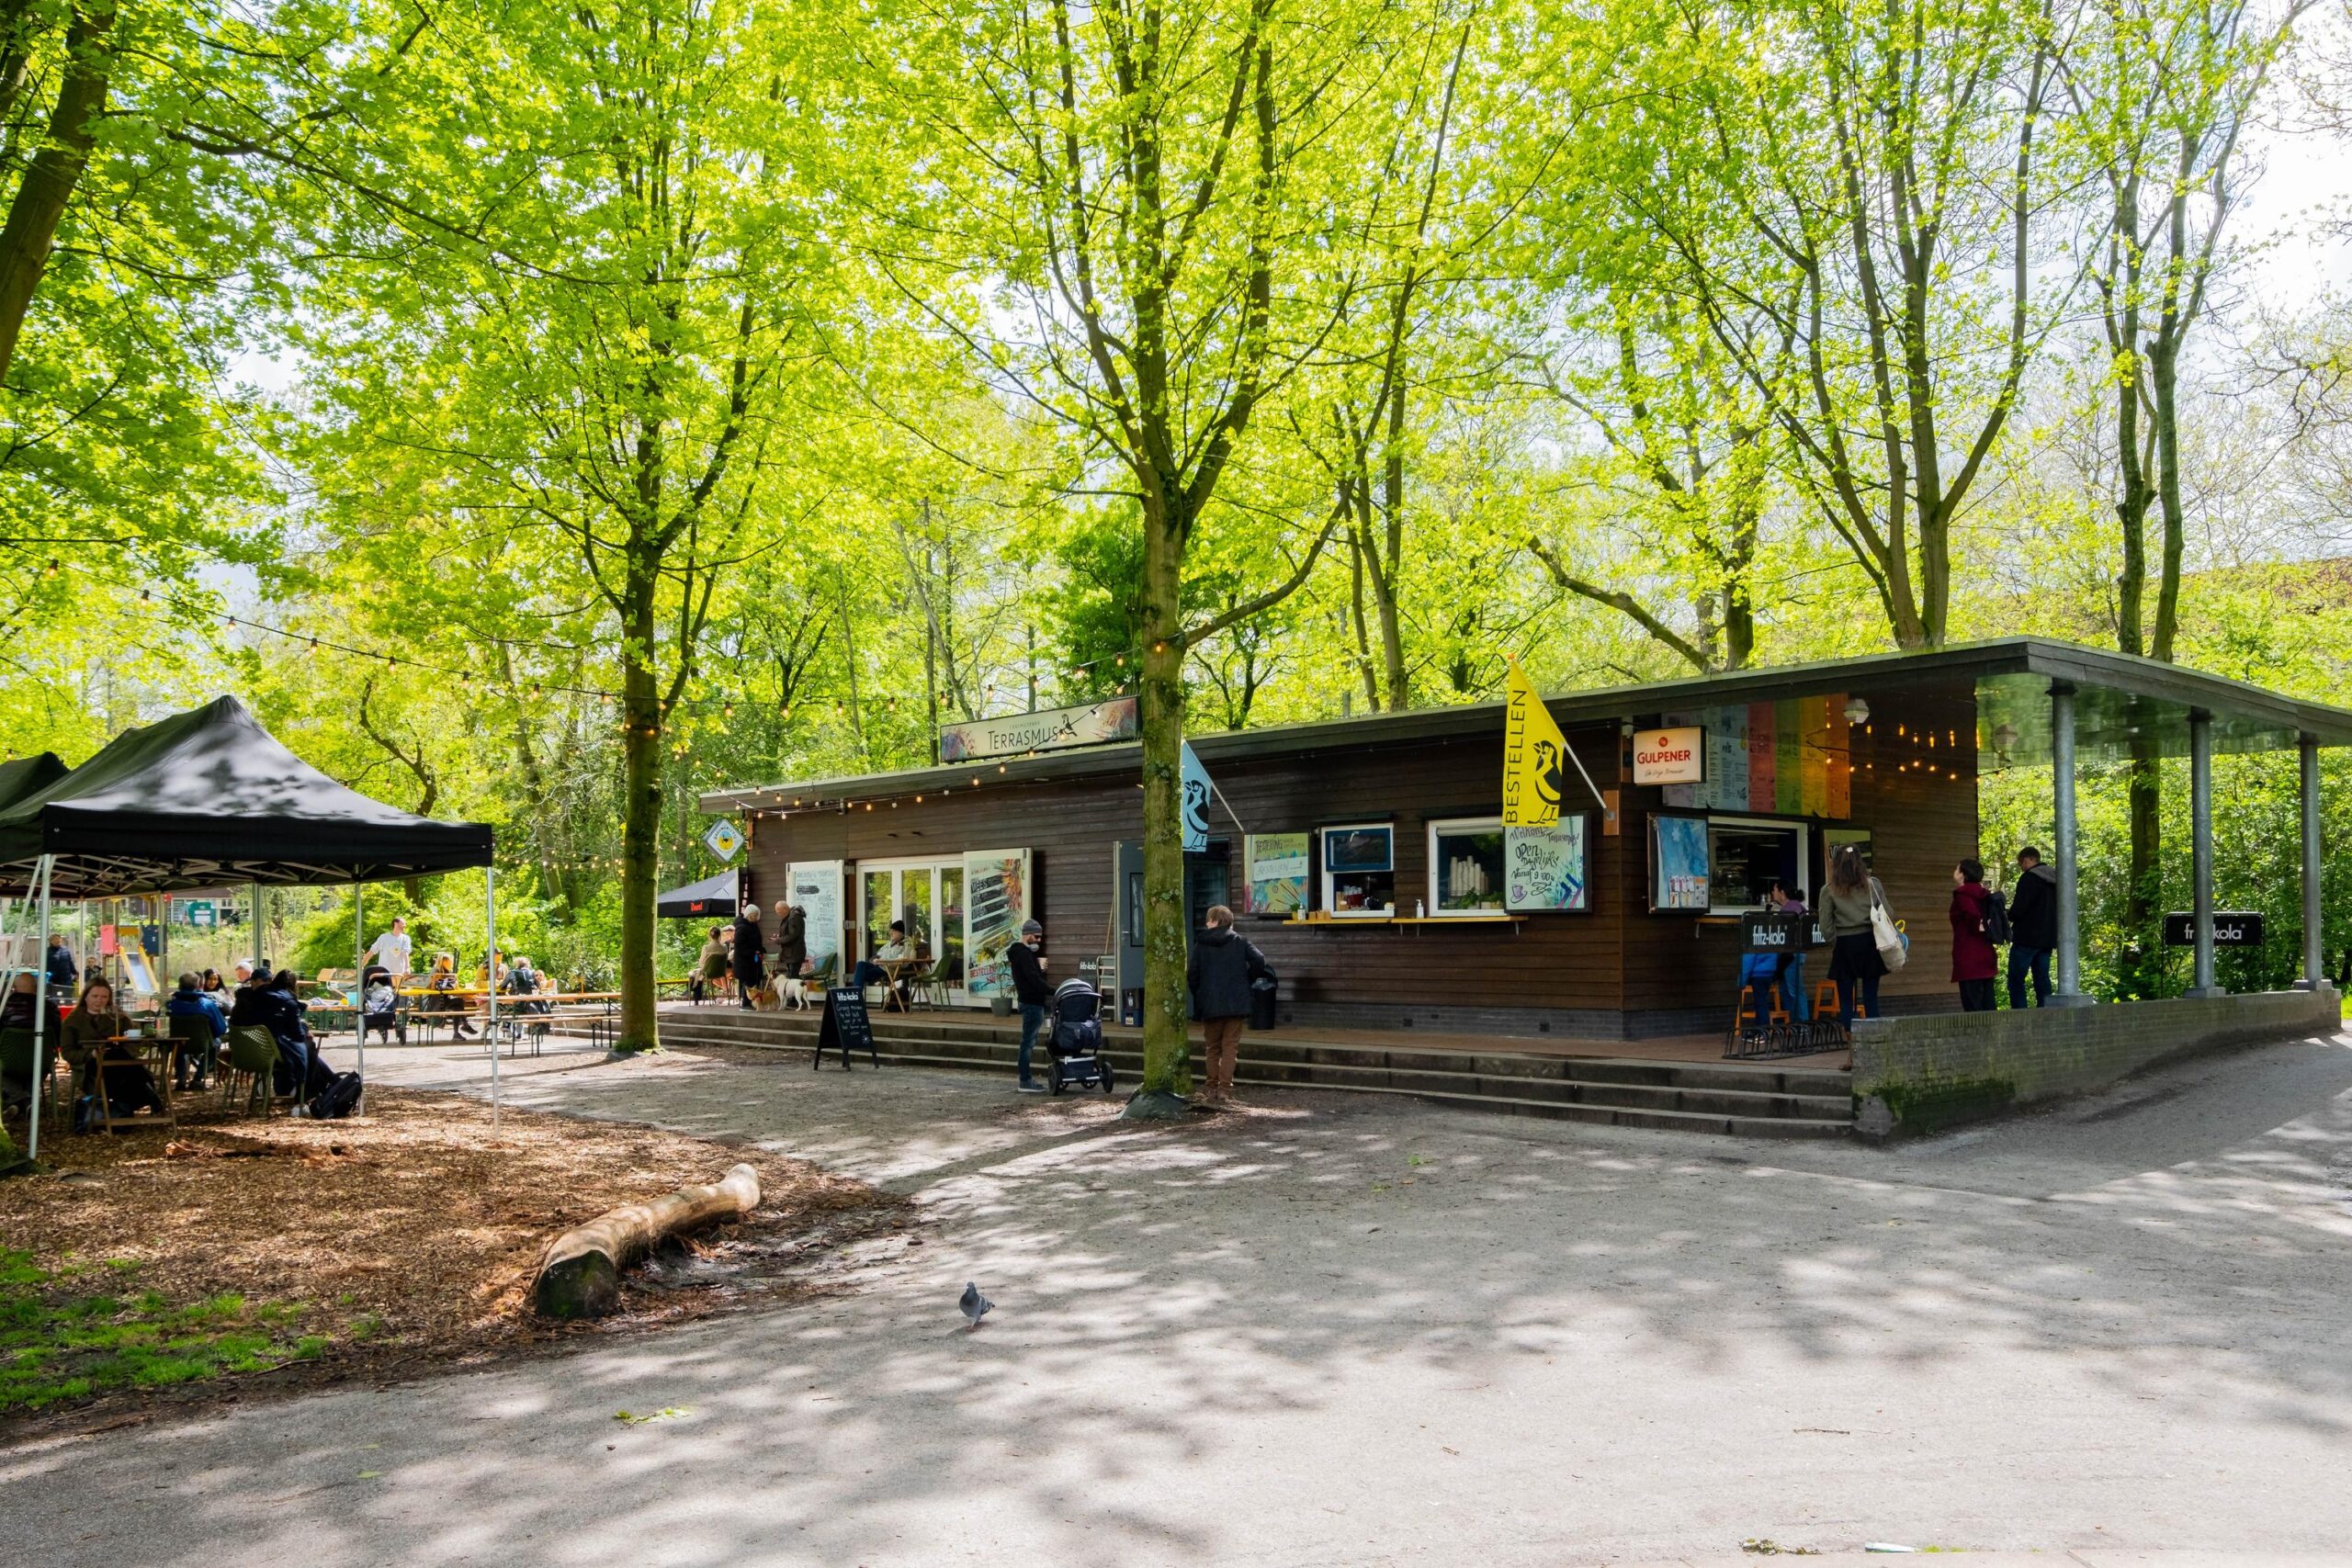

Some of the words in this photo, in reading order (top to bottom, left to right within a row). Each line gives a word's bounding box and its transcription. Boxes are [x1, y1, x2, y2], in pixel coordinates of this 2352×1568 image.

[988, 726, 1058, 750] TERRASMUS
[1505, 690, 1528, 824] BESTELLEN
[1636, 750, 1691, 764] GULPENER
[1752, 924, 1786, 946] fritz-kola
